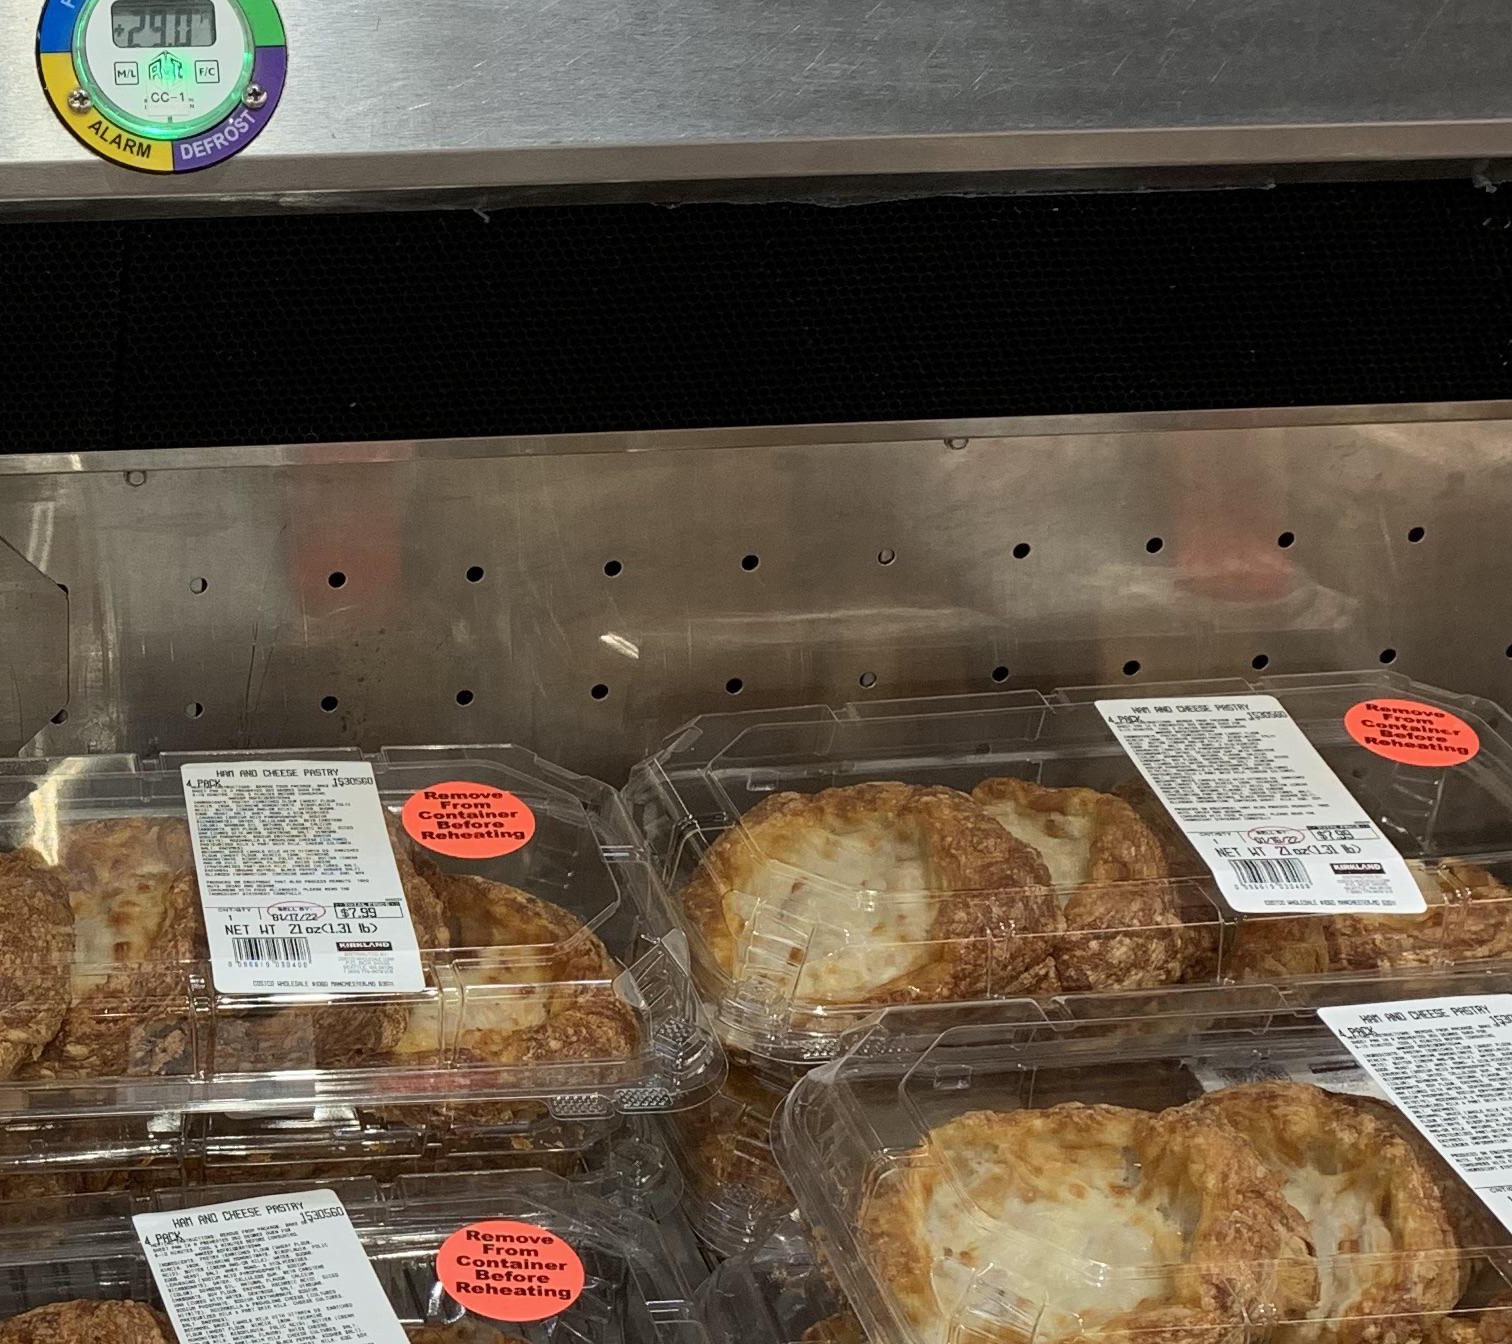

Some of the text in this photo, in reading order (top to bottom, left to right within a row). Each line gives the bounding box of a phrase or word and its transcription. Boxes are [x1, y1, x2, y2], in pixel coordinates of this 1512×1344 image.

[88, 119, 151, 158] ALARM
[181, 110, 256, 160] DEFROST
[1365, 703, 1446, 719] Remove
[1382, 713, 1434, 726] From
[1360, 719, 1462, 737] Container
[1379, 729, 1448, 743] Before
[1364, 736, 1469, 755] Reheating
[424, 791, 503, 801] Remove
[440, 800, 492, 810] From
[418, 809, 518, 820] Container
[436, 819, 504, 830] Before
[421, 828, 525, 840] Reheating
[172, 1201, 304, 1228] HAM AND CHEESE PASTRY
[299, 1207, 344, 1223] 1530560
[155, 1232, 183, 1245] PACK
[466, 1229, 554, 1246] Remove
[482, 1244, 539, 1257] From
[455, 1255, 567, 1272] Container
[475, 1269, 551, 1284] Before
[455, 1282, 572, 1300] Reheating
